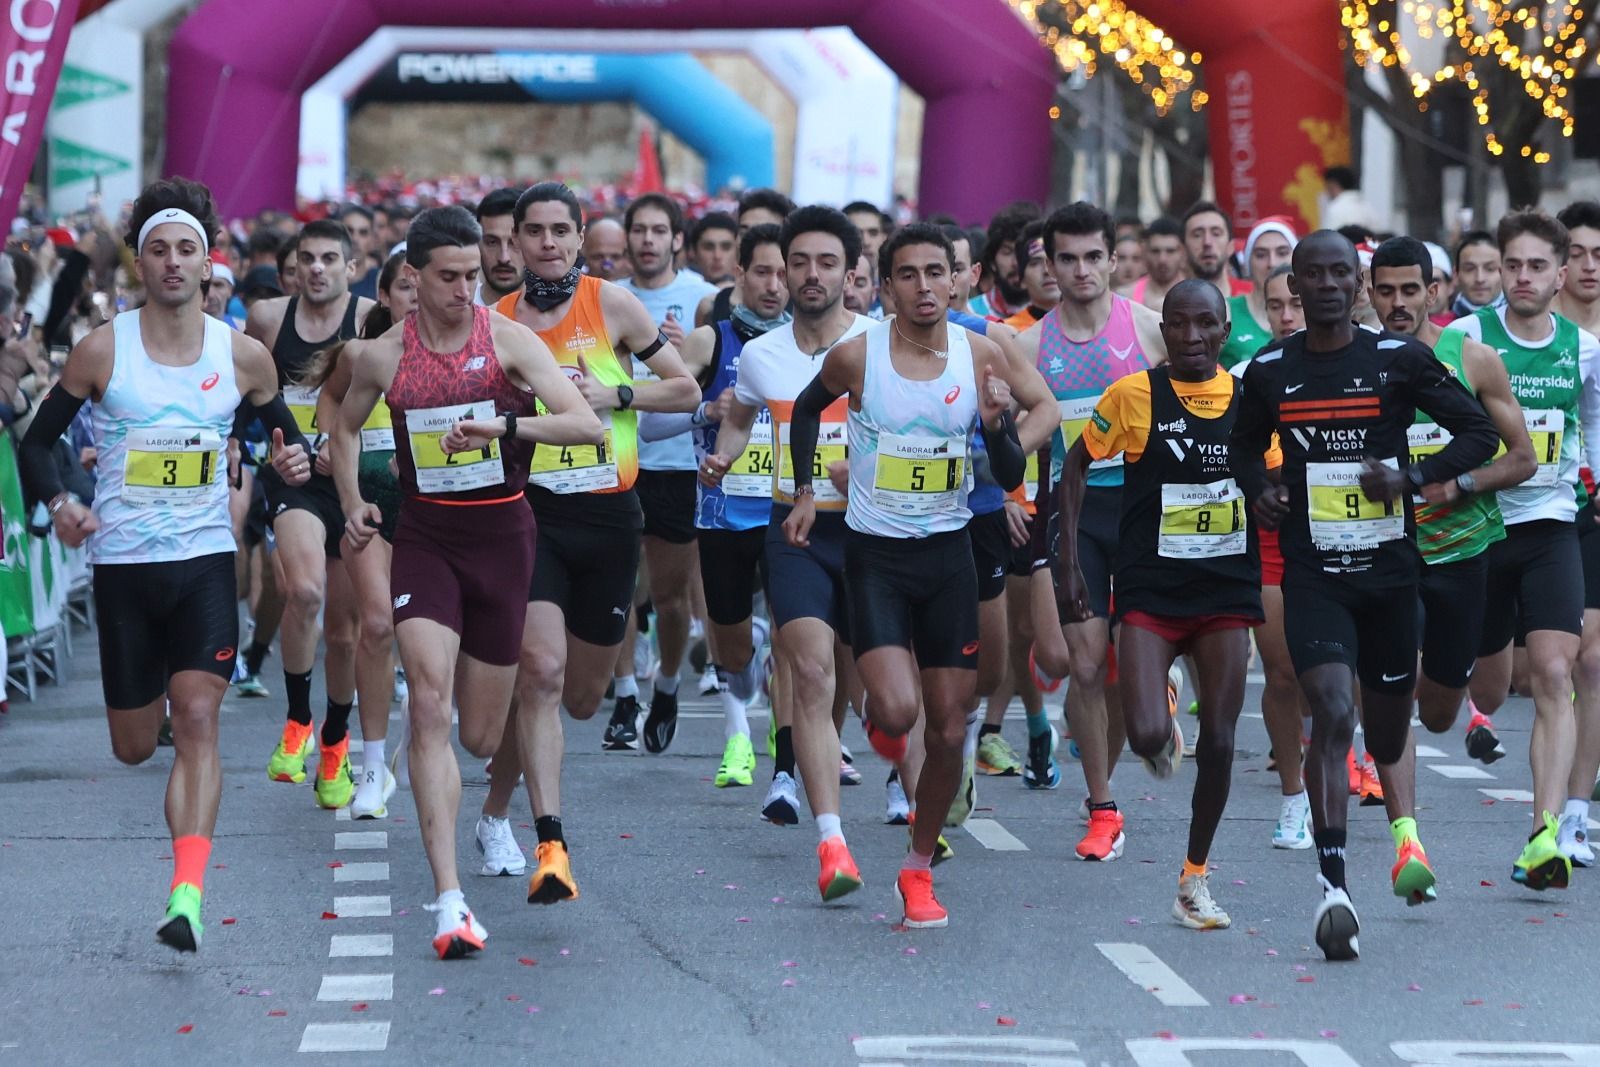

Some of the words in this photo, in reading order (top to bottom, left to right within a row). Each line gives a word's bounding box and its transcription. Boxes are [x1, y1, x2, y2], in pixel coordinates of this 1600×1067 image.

[398, 54, 597, 83] POWERADE
[1518, 384, 1545, 399] león
[1074, 406, 1093, 415] LABO
[1158, 422, 1169, 432] be
[1320, 428, 1368, 442] VICKY
[896, 445, 933, 454] LABORAL
[1198, 444, 1229, 456] VICK
[1326, 441, 1365, 451] FOODS
[748, 451, 773, 474] 34
[163, 460, 177, 485] 3
[911, 466, 925, 491] 5
[1326, 473, 1361, 481] LABORA
[1181, 492, 1218, 500] LABORAL
[1345, 493, 1360, 518] 9
[1196, 511, 1211, 532] 8
